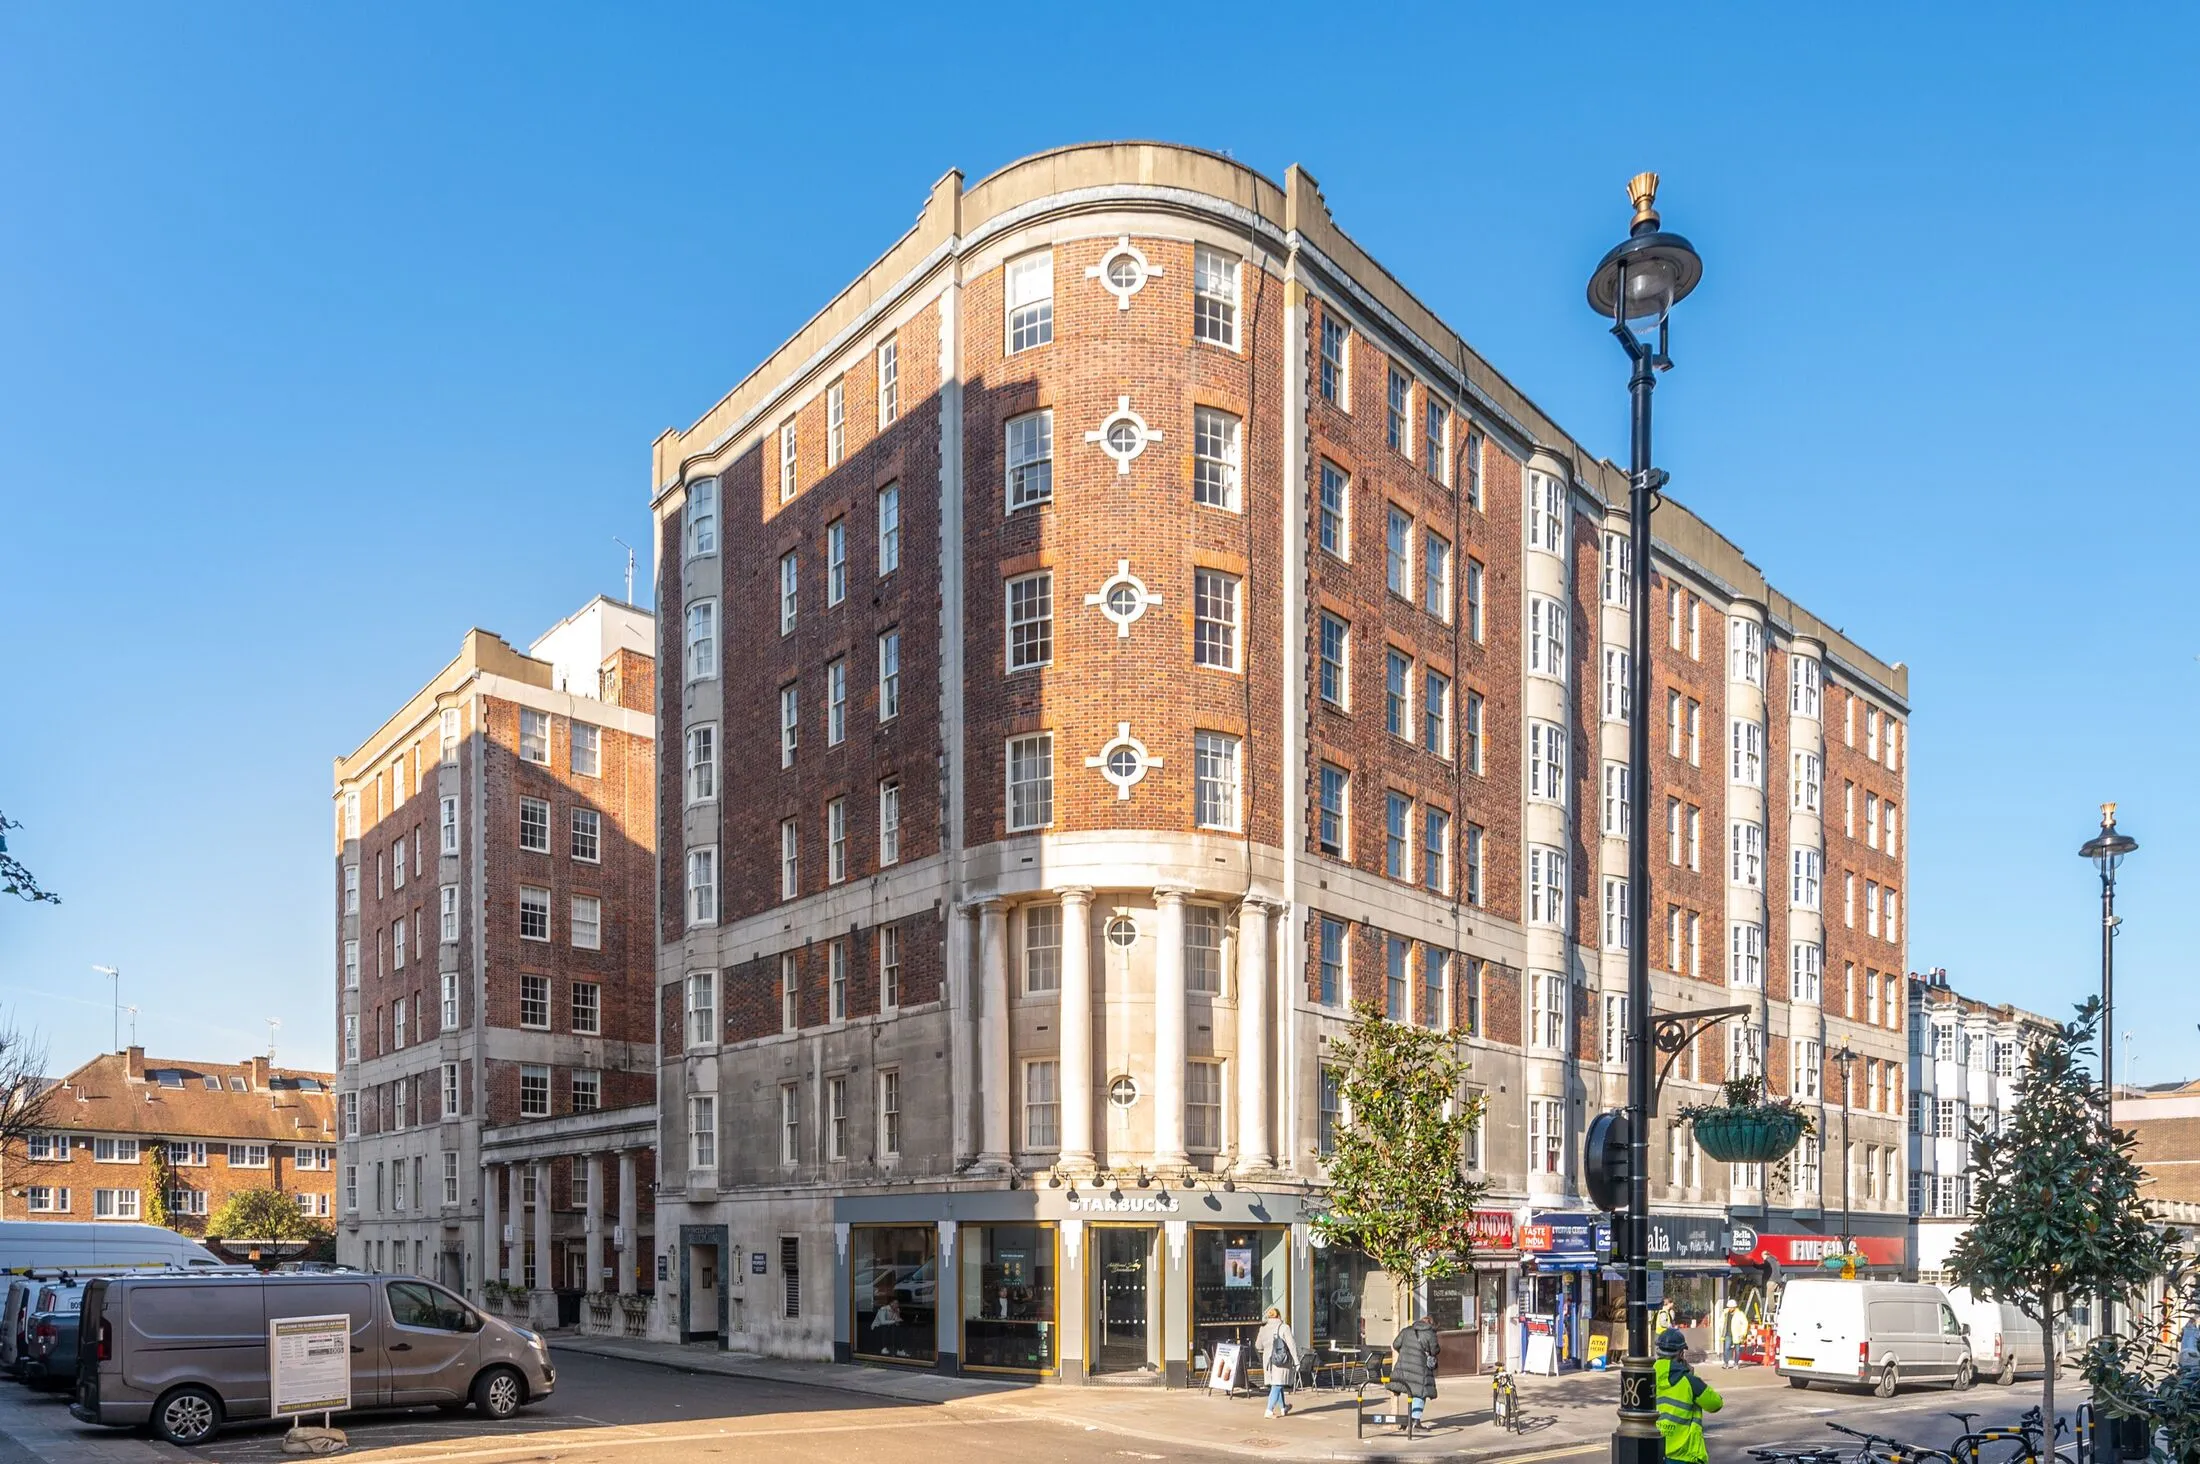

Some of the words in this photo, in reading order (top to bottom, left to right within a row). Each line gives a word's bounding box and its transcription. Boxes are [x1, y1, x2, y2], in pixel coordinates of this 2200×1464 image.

[1069, 1197, 1180, 1213] STARBUCKS
[1479, 1214, 1512, 1237] INDIA
[1523, 1227, 1547, 1237] TASTE
[1733, 1230, 1752, 1239] Bella
[1525, 1238, 1545, 1247] INDIA
[1647, 1225, 1671, 1253] alia
[1732, 1238, 1752, 1247] Italia
[1790, 1239, 1823, 1261] FIVE
[1823, 1240, 1857, 1258] GUS
[1591, 1339, 1606, 1347] ATM
